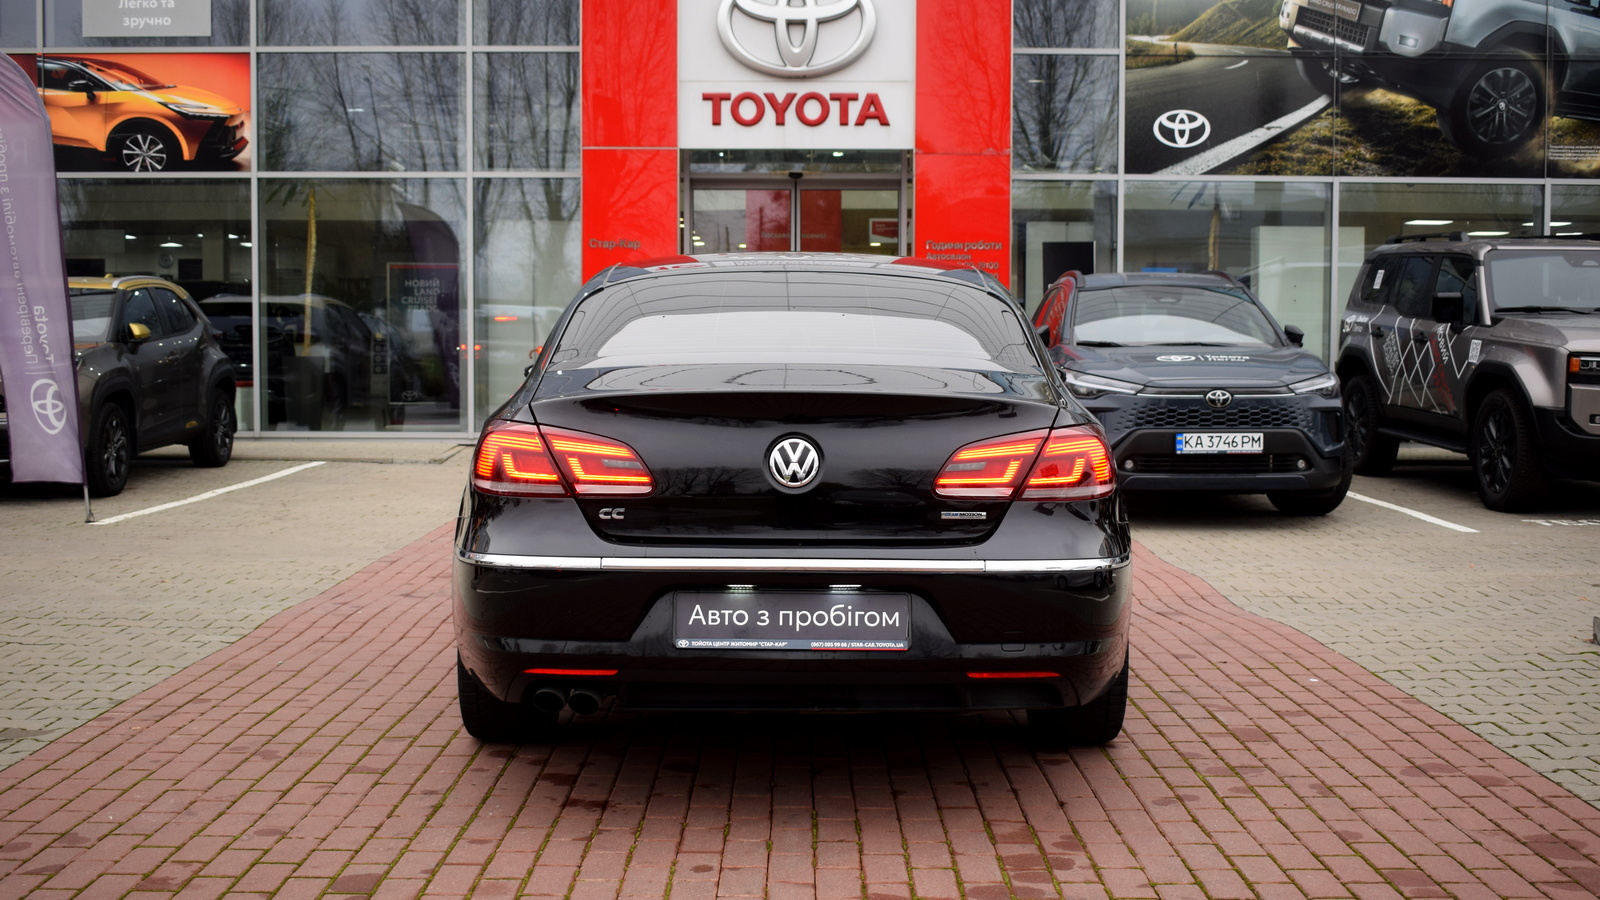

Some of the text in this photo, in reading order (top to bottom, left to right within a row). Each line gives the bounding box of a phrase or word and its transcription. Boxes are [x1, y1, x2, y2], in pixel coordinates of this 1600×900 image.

[118, 0, 175, 9] Легко та
[123, 16, 172, 29] зручно
[702, 91, 891, 127] TOYOTA
[589, 238, 641, 251] Стар-Кар
[925, 240, 1002, 252] Години роботи
[926, 252, 972, 260] Автосалон
[404, 277, 441, 287] НОВИЙ
[414, 288, 441, 296] LAND
[1184, 435, 1261, 448] KA 3746 PM
[598, 507, 626, 520] CC
[688, 604, 900, 631] Авто з пробігом
